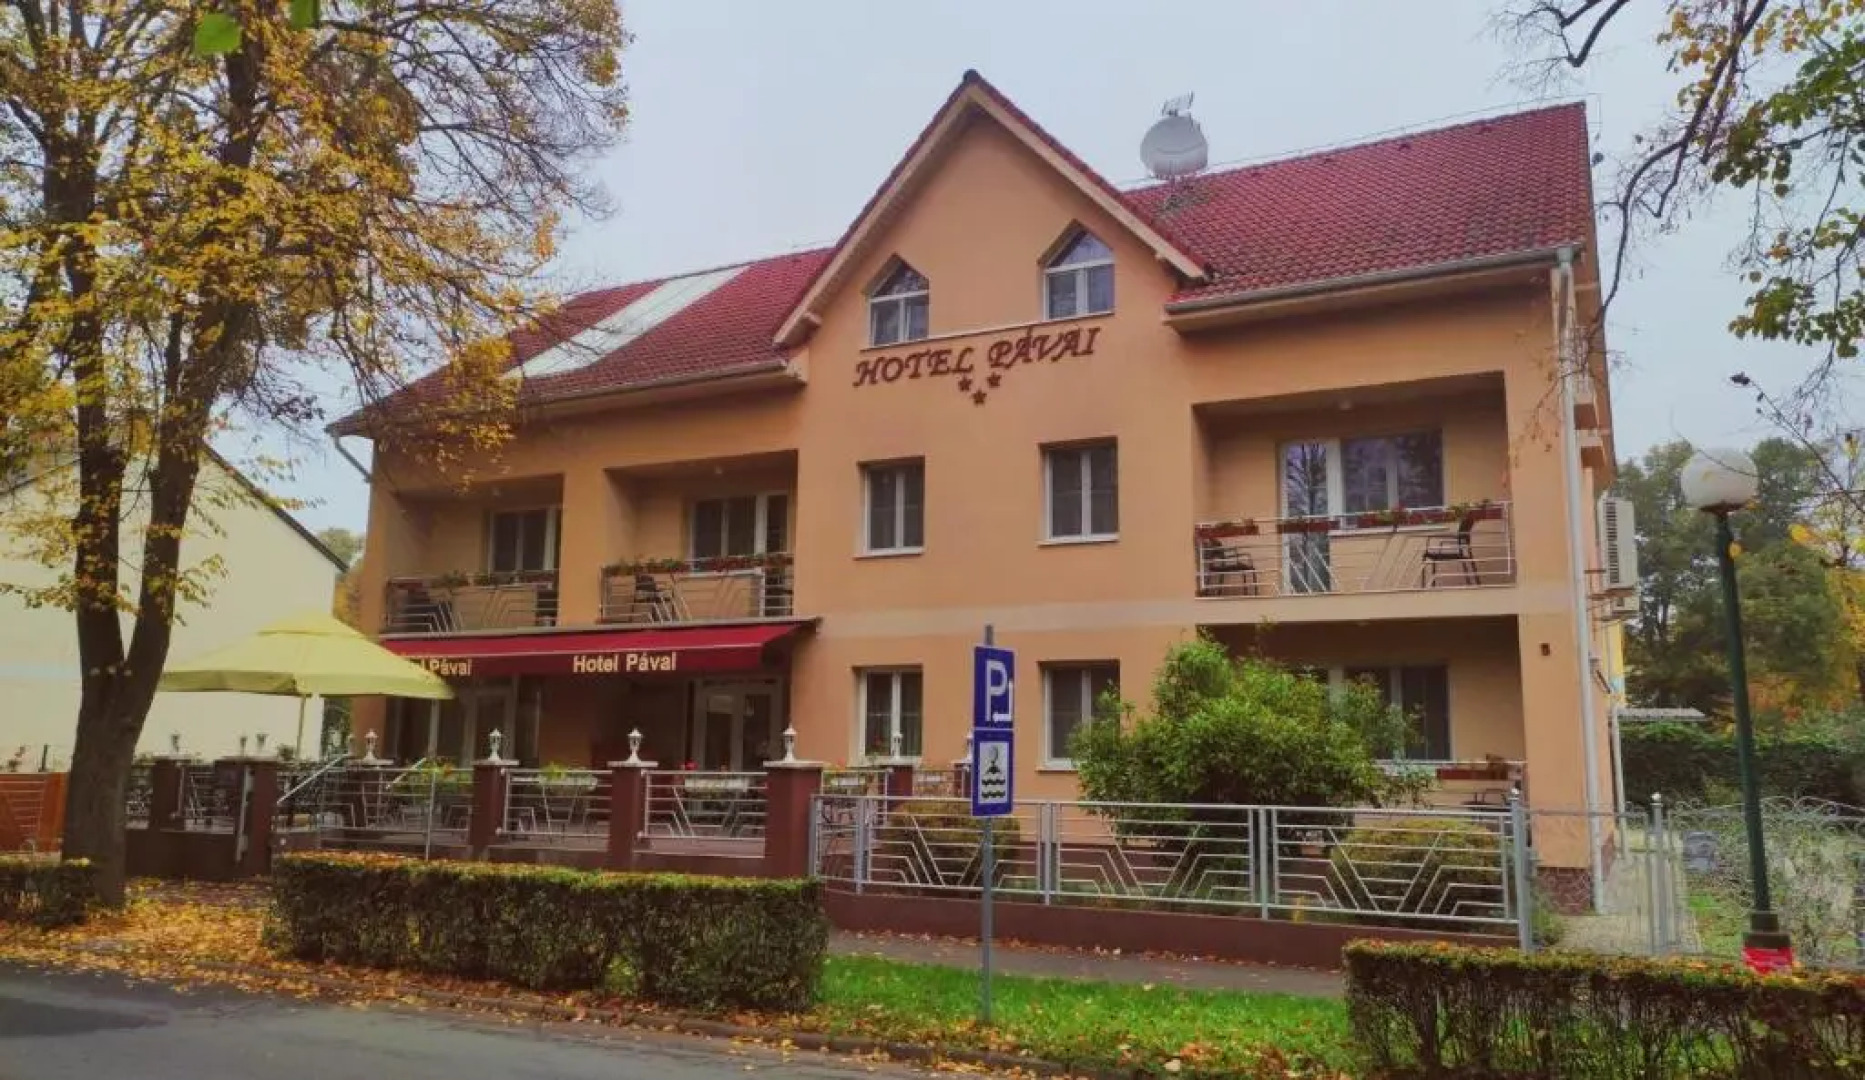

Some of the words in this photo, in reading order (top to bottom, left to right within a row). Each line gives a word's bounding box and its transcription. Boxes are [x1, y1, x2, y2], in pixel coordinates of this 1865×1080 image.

[853, 347, 974, 388] HOTEL
[988, 326, 1100, 370] PÁVAI
[573, 654, 619, 673] Hotel
[985, 660, 1008, 721] P
